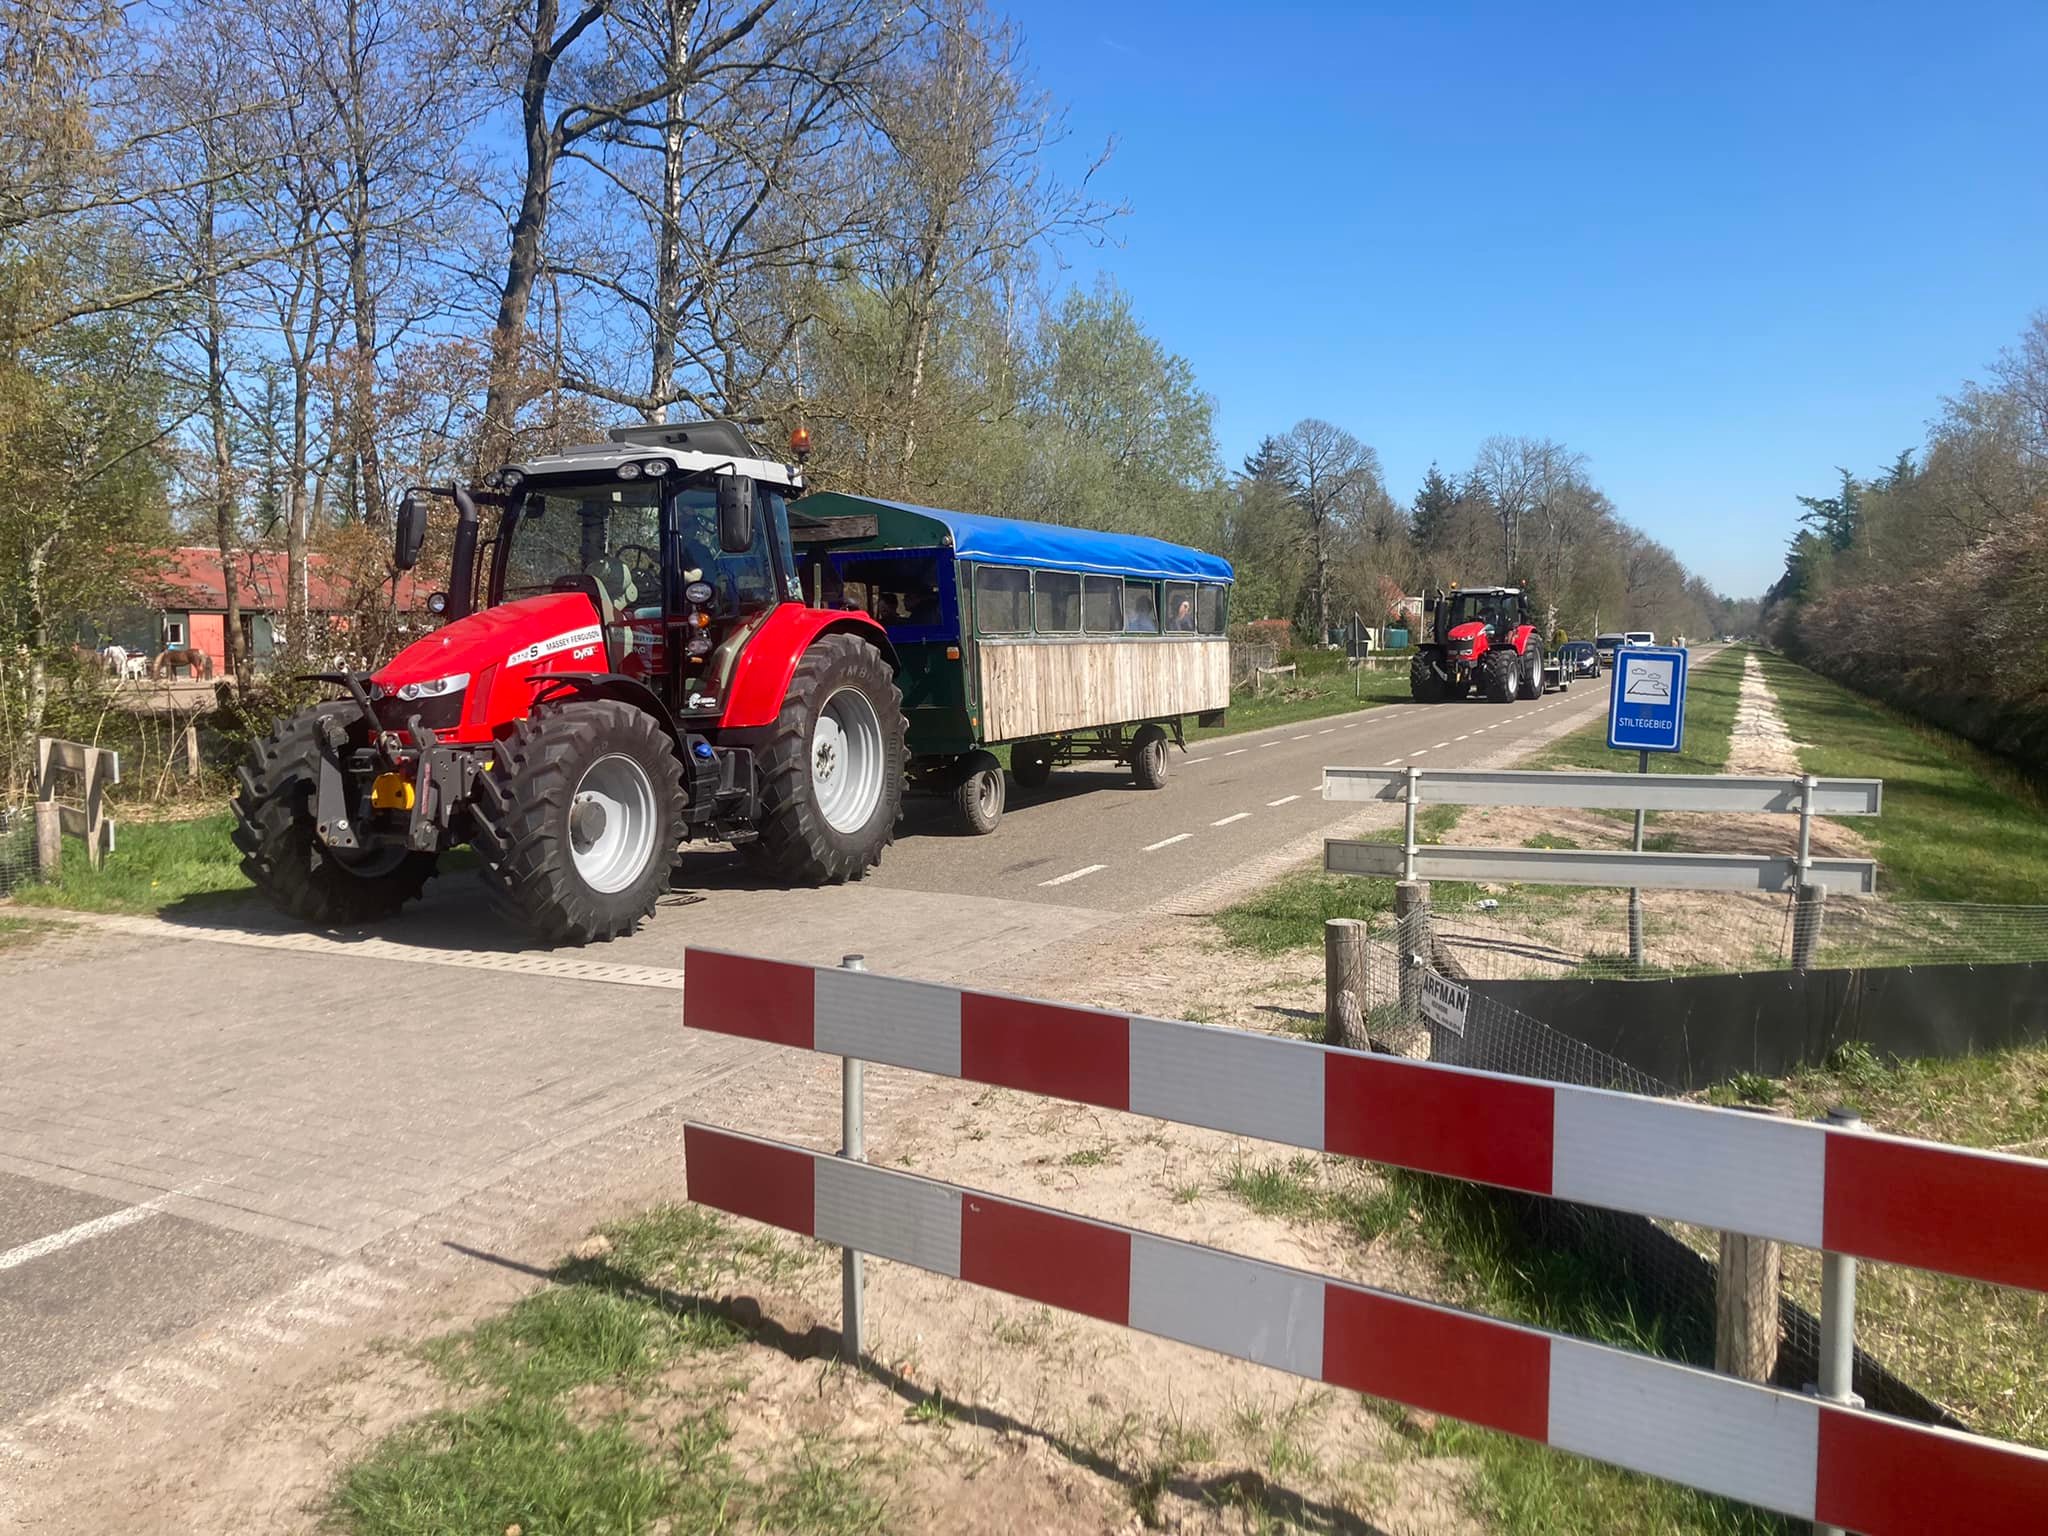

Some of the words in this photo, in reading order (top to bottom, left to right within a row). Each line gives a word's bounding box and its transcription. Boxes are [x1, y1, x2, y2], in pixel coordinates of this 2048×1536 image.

[546, 638, 570, 650] MASSEY
[570, 631, 600, 643] FERGUSON
[1618, 717, 1673, 730] STILTEGEBIED
[1423, 974, 1466, 1012] ARFMAN
